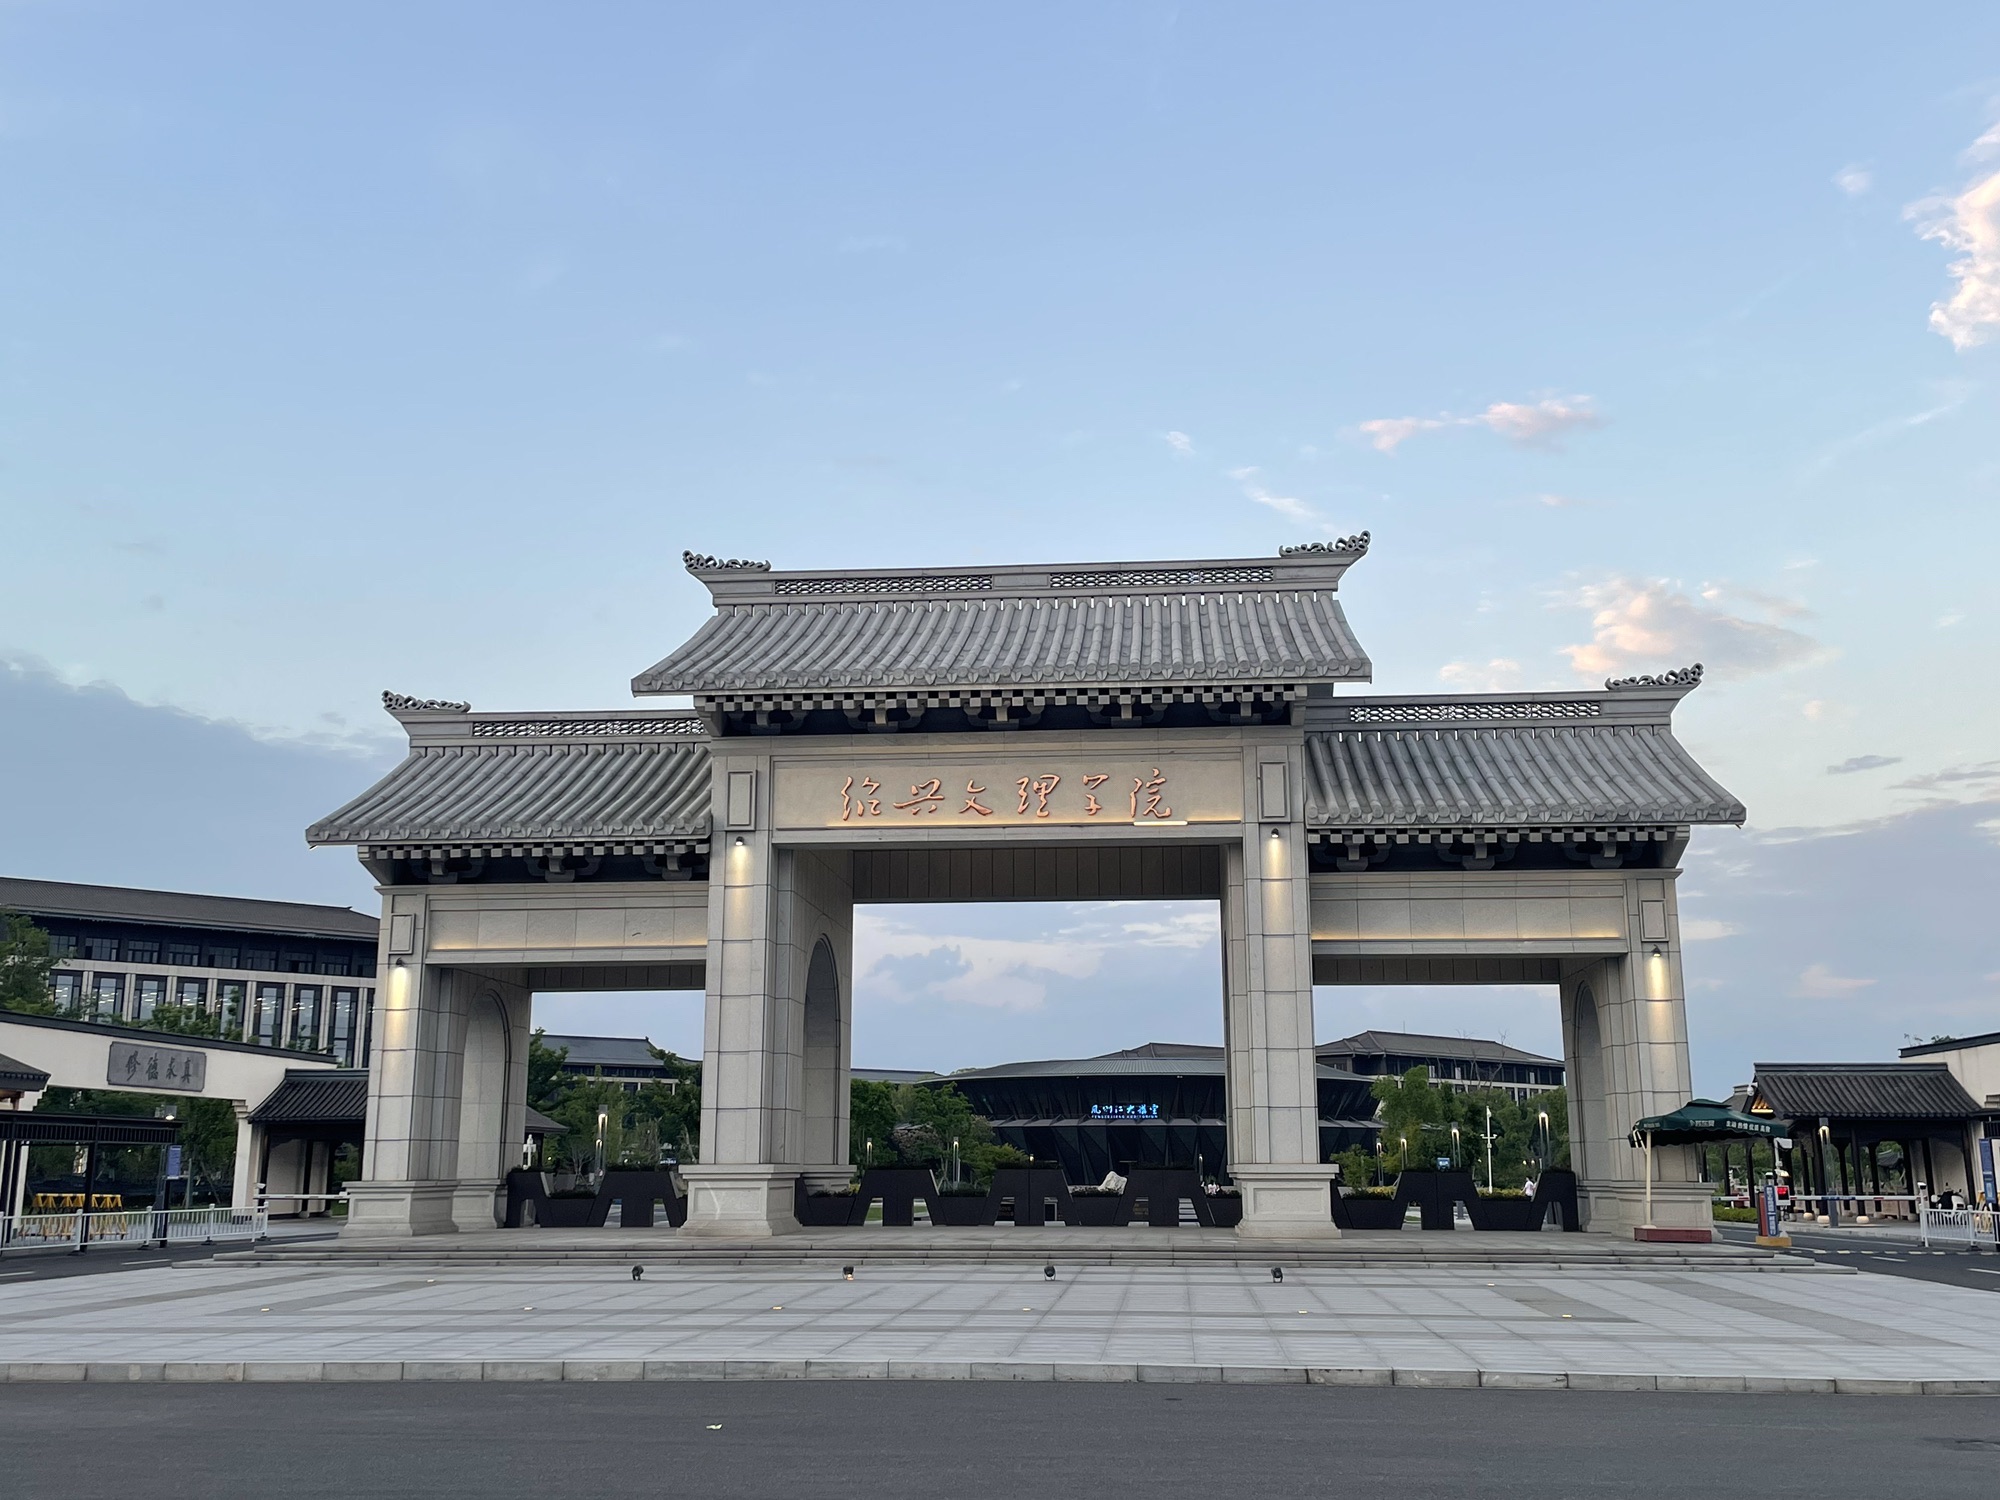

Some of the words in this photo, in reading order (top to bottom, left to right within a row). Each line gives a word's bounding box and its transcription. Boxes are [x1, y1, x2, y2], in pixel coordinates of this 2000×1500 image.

[841, 768, 1171, 820] 绍兴文理学院
